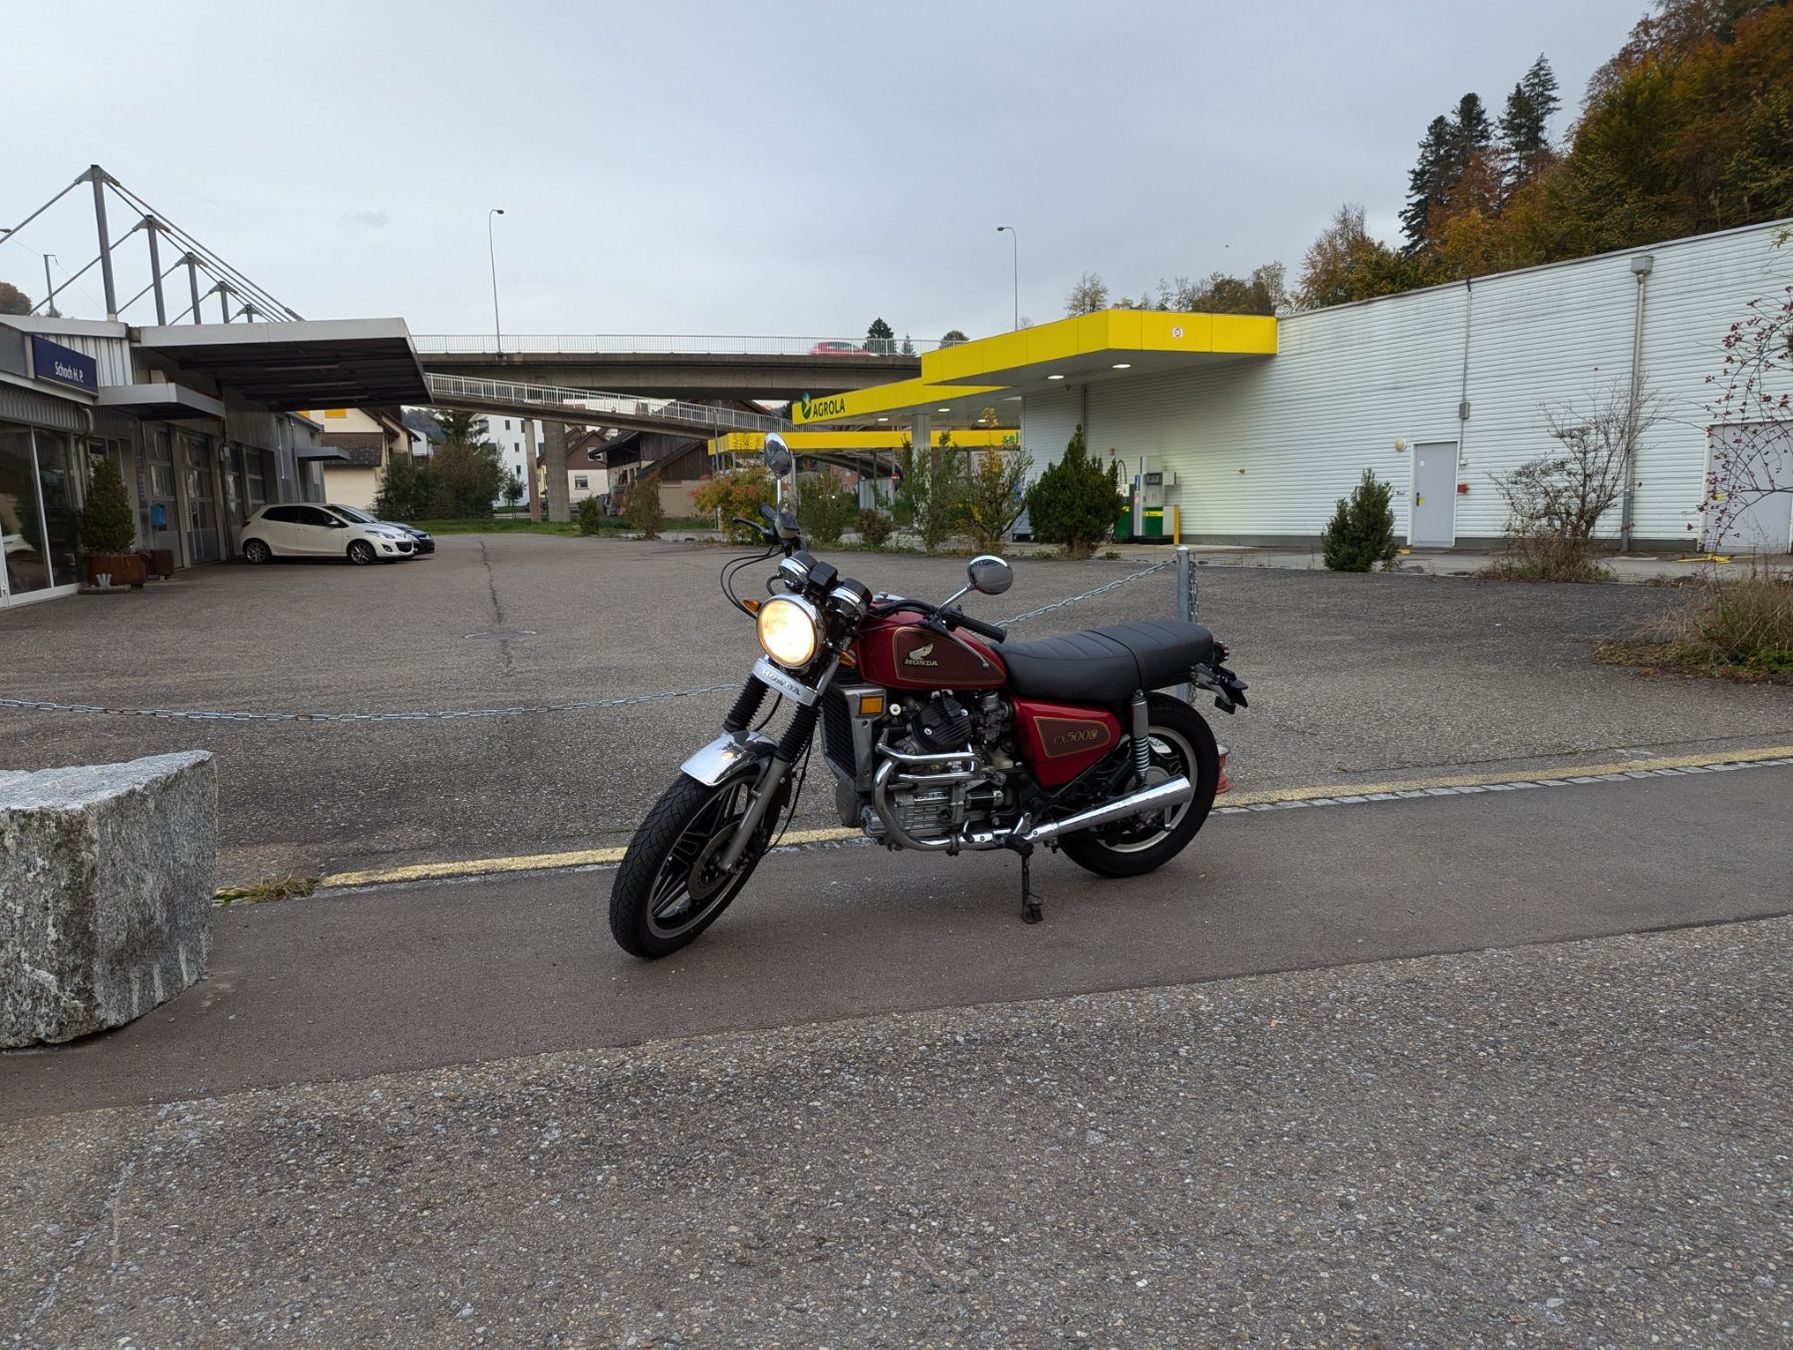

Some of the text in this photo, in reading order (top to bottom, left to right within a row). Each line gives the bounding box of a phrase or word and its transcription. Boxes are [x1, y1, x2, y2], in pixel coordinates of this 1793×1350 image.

[54, 361, 73, 380] Schoch
[813, 398, 846, 418] AGROLA
[1002, 431, 1021, 445] sel
[761, 669, 801, 696] HONDA
